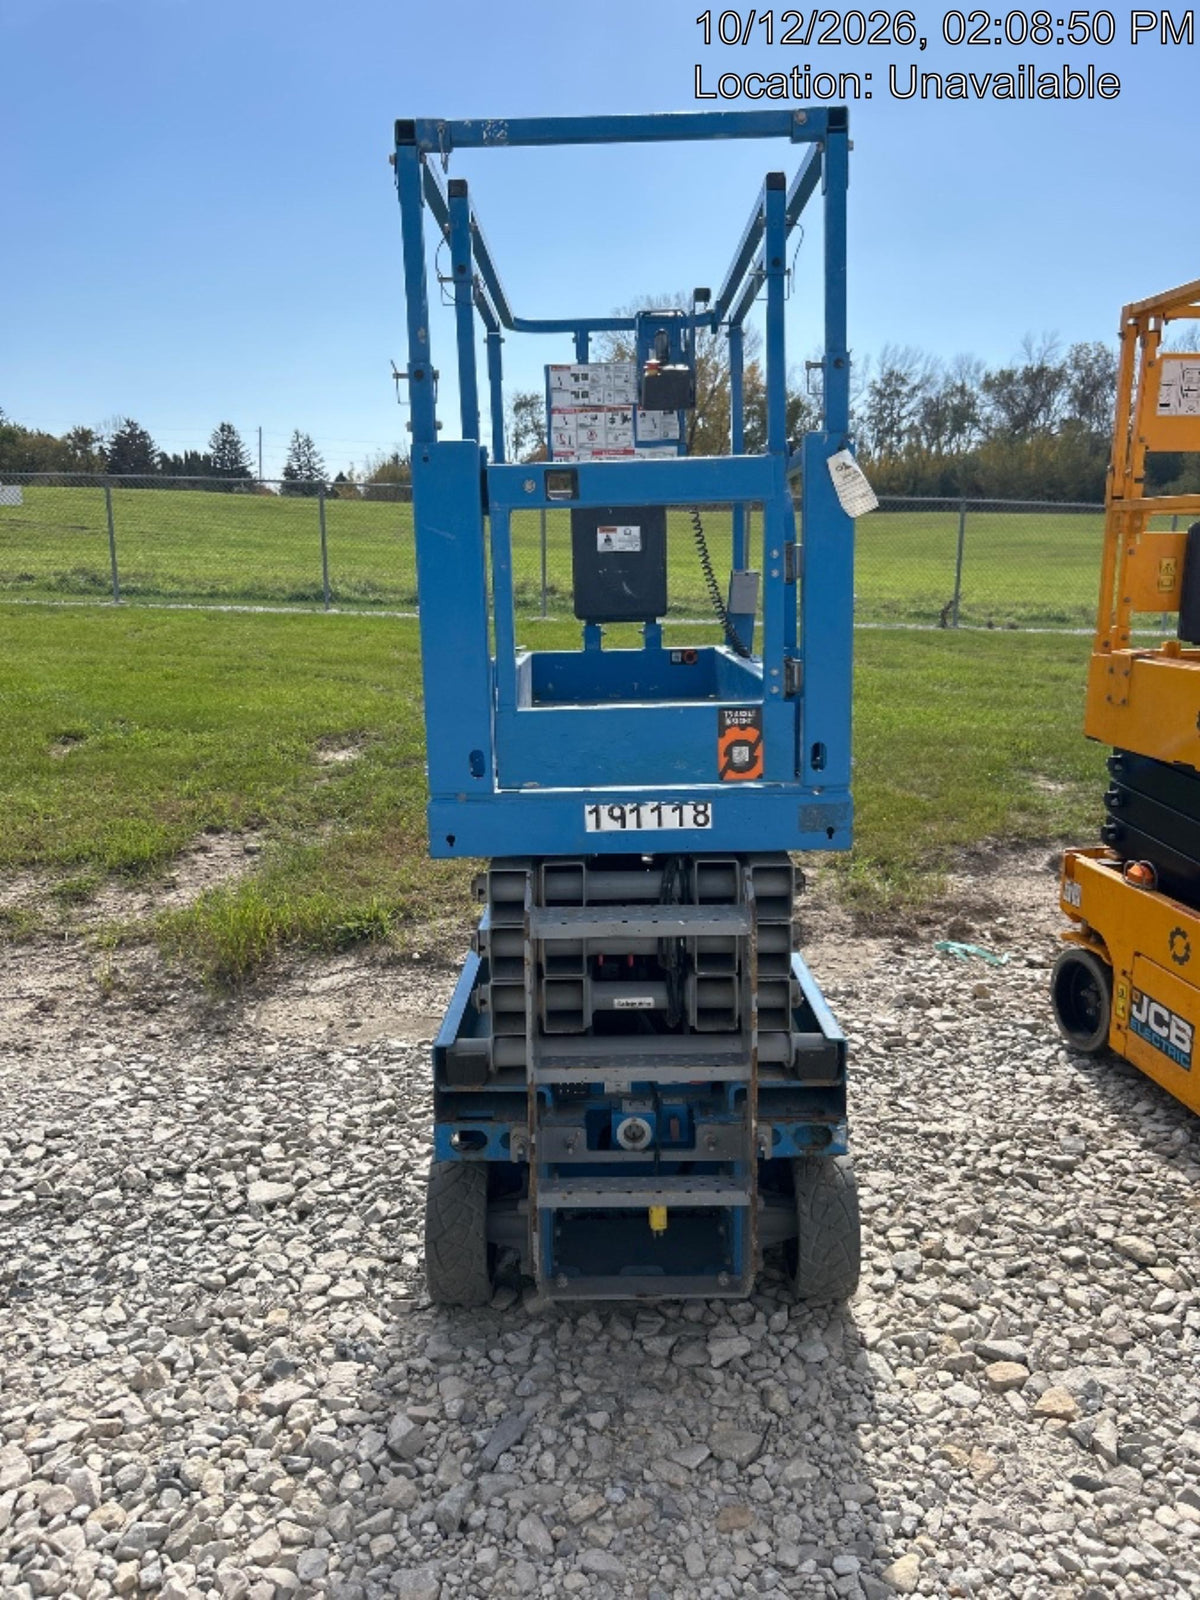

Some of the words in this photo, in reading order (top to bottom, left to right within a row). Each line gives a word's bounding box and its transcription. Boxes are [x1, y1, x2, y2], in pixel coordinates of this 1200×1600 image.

[588, 804, 710, 830] 191118
[1130, 1017, 1191, 1071] ELECTRIC
[1131, 994, 1193, 1054] JCB
